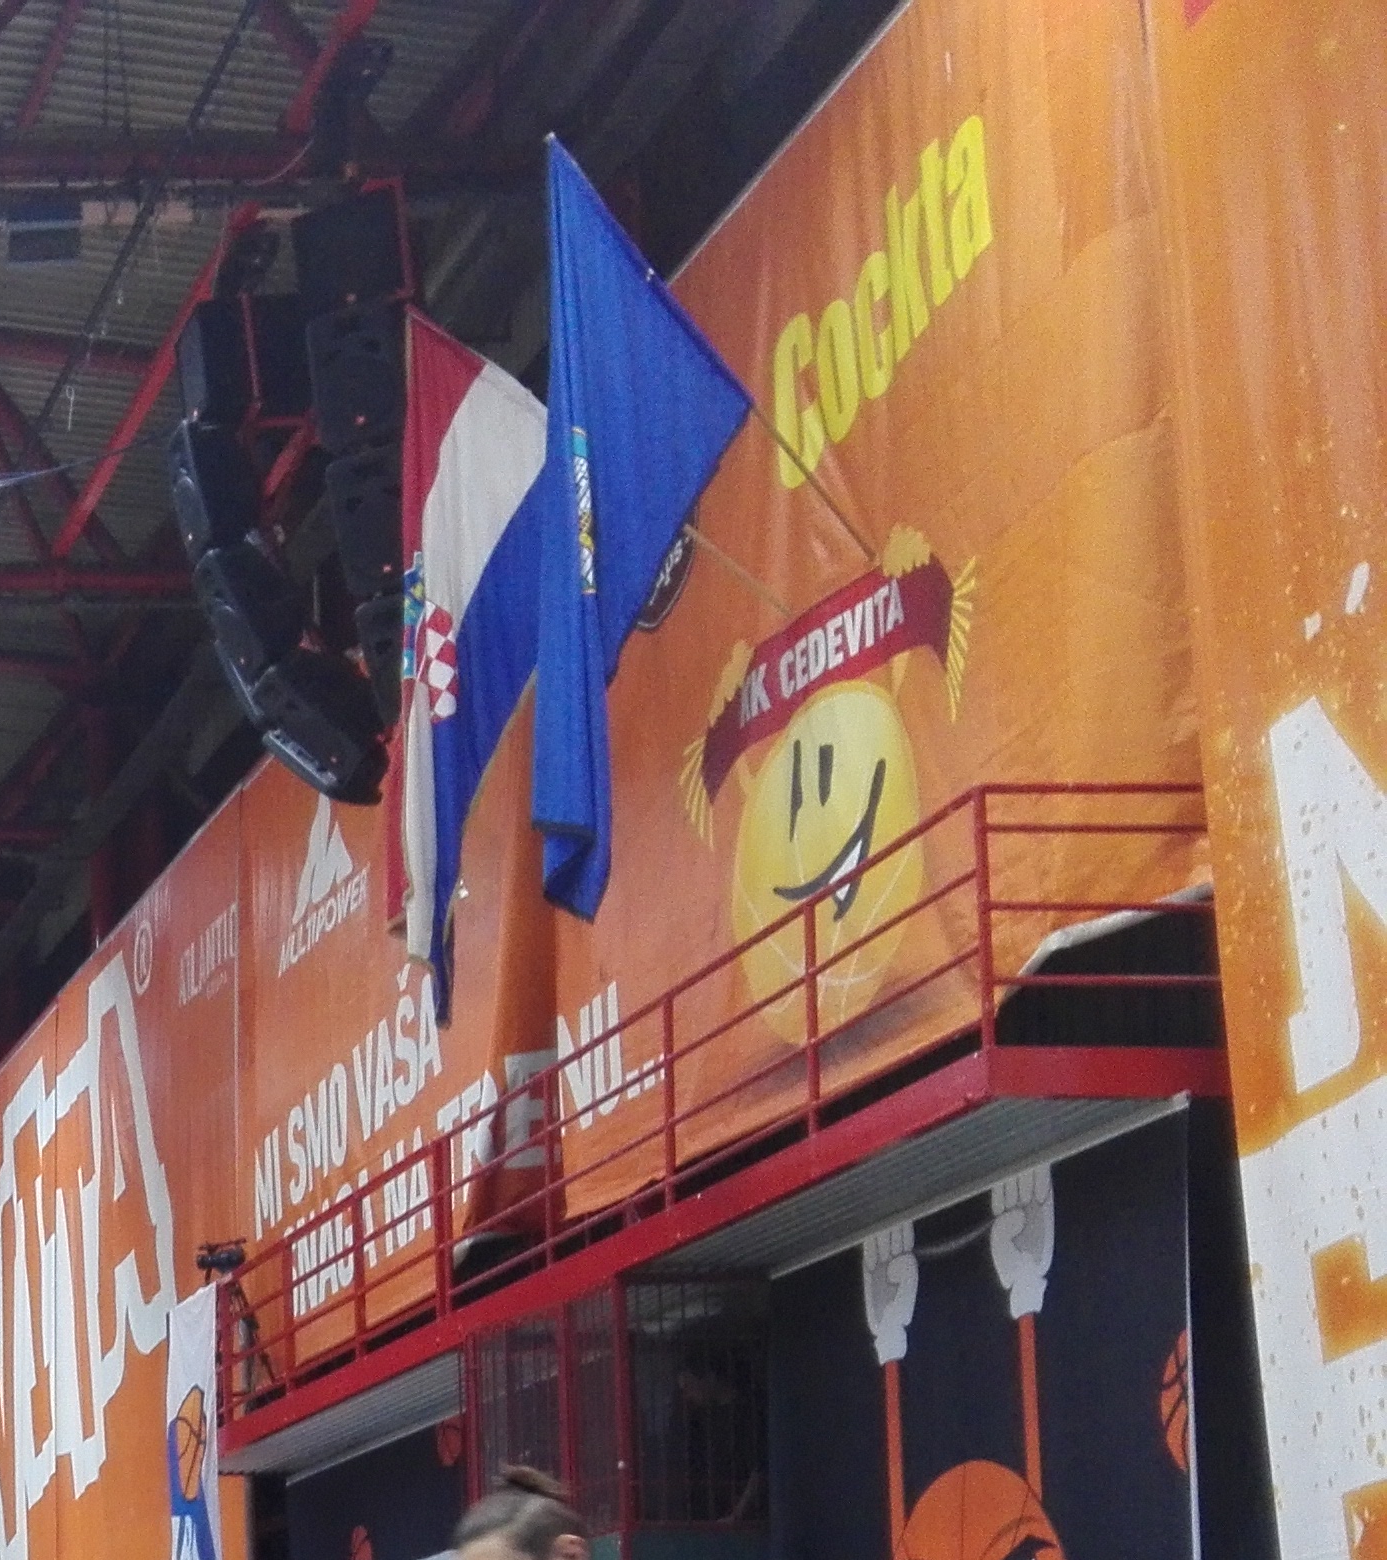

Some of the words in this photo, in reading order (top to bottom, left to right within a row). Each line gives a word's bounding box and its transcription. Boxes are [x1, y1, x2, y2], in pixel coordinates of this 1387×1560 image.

[772, 114, 993, 489] Cockta
[779, 577, 905, 699] CEDEVITA
[254, 1124, 283, 1242] MI
[288, 1063, 348, 1205] SMO
[352, 963, 442, 1142] VAŠA
[283, 1167, 377, 1319] NAGA
[382, 1125, 432, 1257] NA
